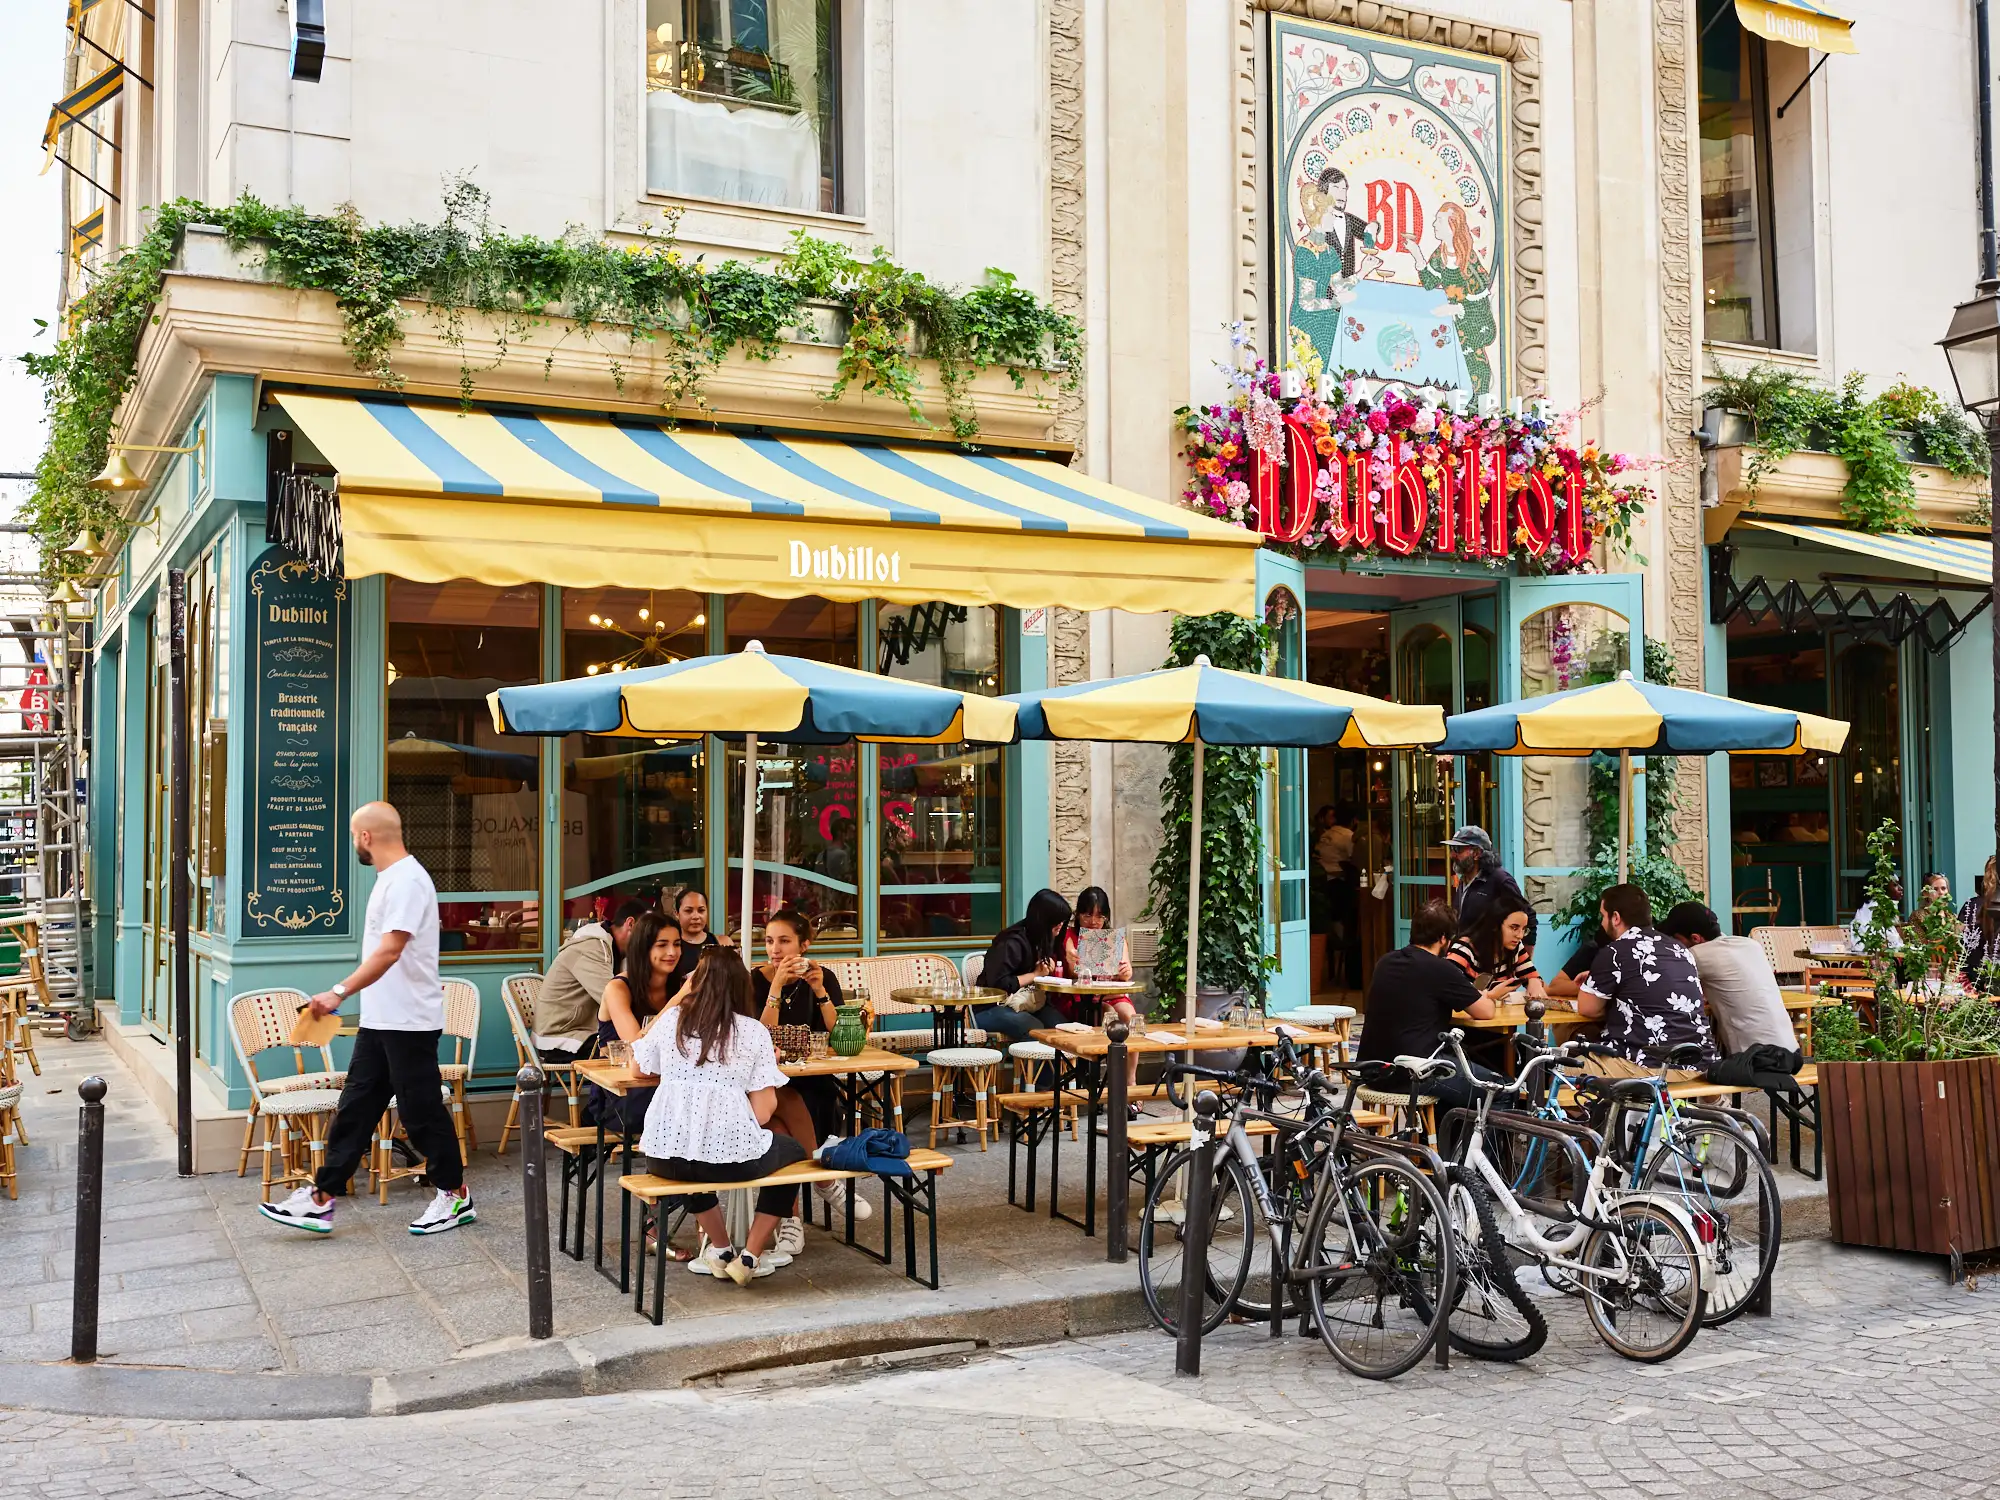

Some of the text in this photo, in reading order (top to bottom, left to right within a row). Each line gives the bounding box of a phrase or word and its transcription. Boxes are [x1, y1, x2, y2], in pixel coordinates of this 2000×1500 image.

[1765, 10, 1820, 45] Dubillot
[1364, 179, 1424, 253] BD
[1279, 370, 1557, 426] BRASSERIE
[1248, 413, 1590, 563] Dubillot
[788, 540, 901, 584] Dubillot
[269, 604, 328, 625] Dubillot
[264, 637, 282, 647] TEMPLE
[266, 668, 297, 679] Cantine
[278, 692, 318, 704] Brasserie
[270, 707, 326, 719] traditionnelle
[277, 721, 318, 735] française
[297, 796, 323, 804] FRANÇAIS
[266, 803, 284, 811] FRAIS
[304, 803, 327, 812] SAISON
[266, 884, 326, 894] DIRECT PRODUCTEURS
